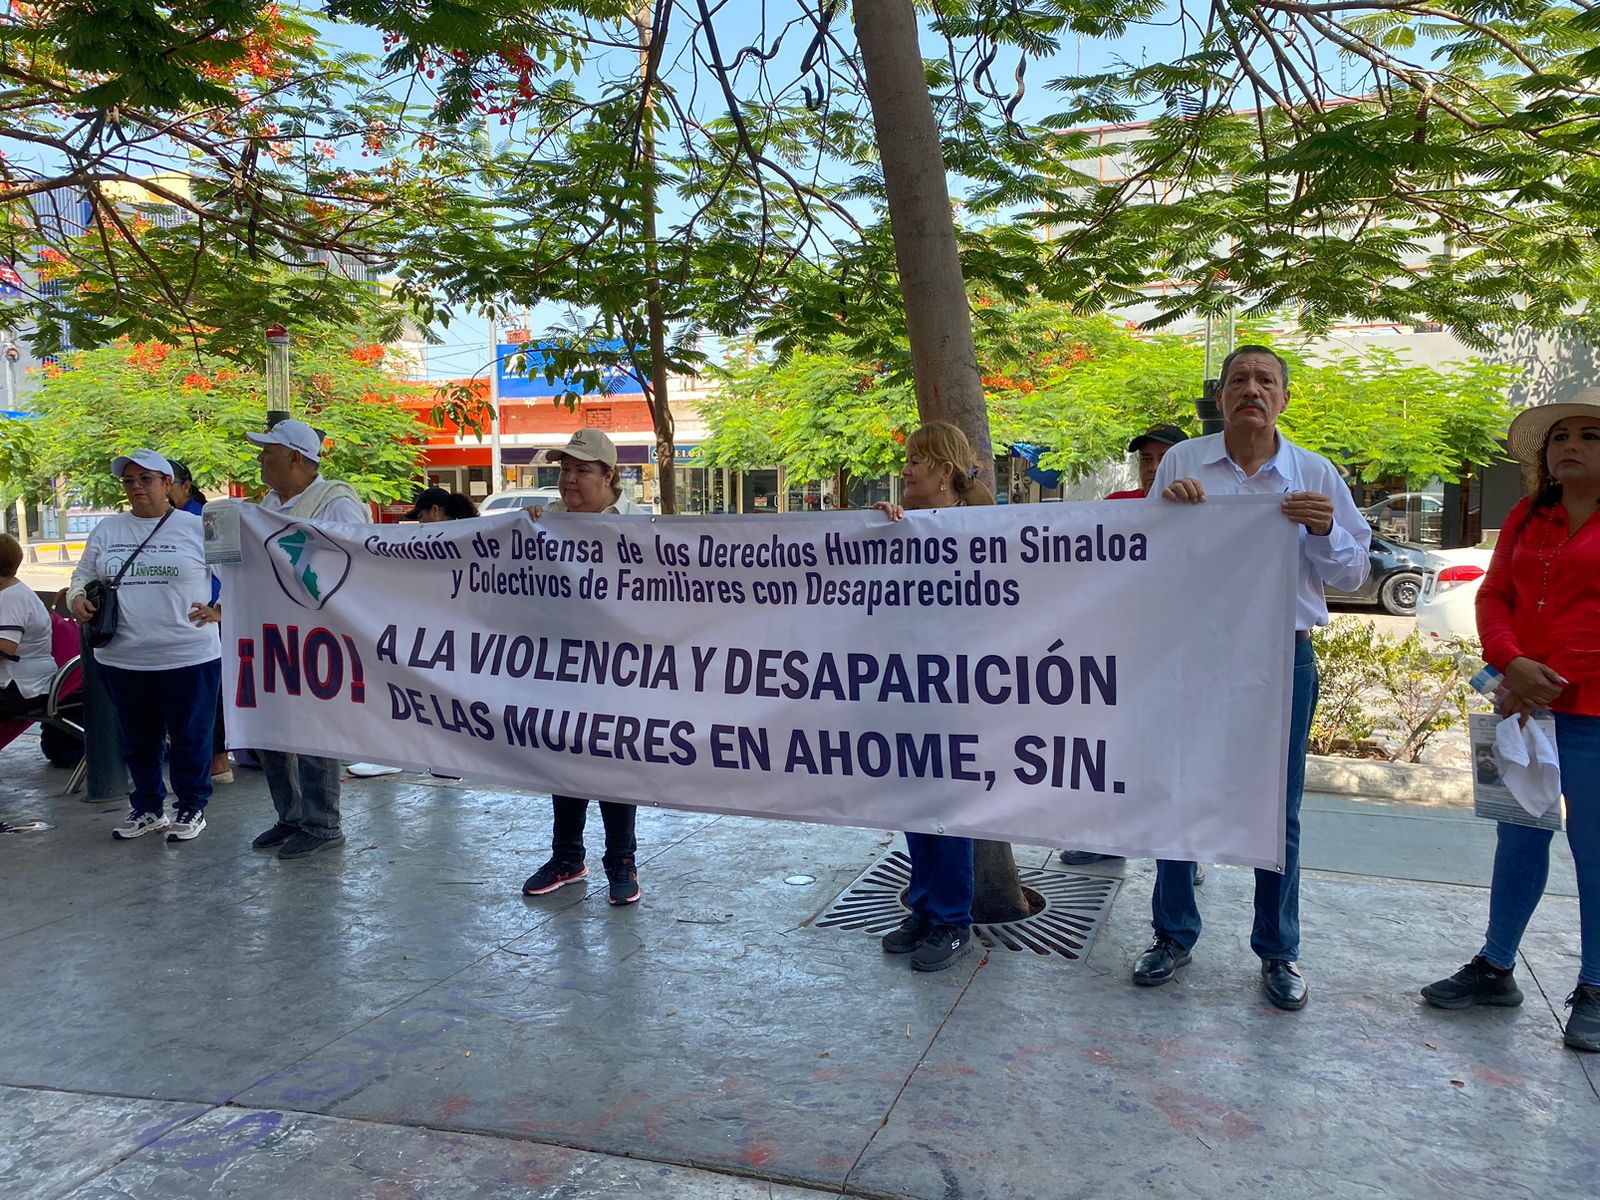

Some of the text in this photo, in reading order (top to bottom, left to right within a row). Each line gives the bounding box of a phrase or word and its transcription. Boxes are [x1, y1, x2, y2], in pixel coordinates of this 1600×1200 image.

[135, 565, 179, 576] ANIVERSARIO
[364, 524, 1147, 568] Comisión de Defensa de los Derechos Humanos en Sinaloa
[451, 562, 1020, 616] y Colectivos de Familiares con Desaparecidos
[235, 623, 1117, 708] ¡NO! A LA VIOLENCIA Y DESAPARICIÓN
[387, 682, 1126, 794] DE LAS MUJERES EN AHOME, SIN.
